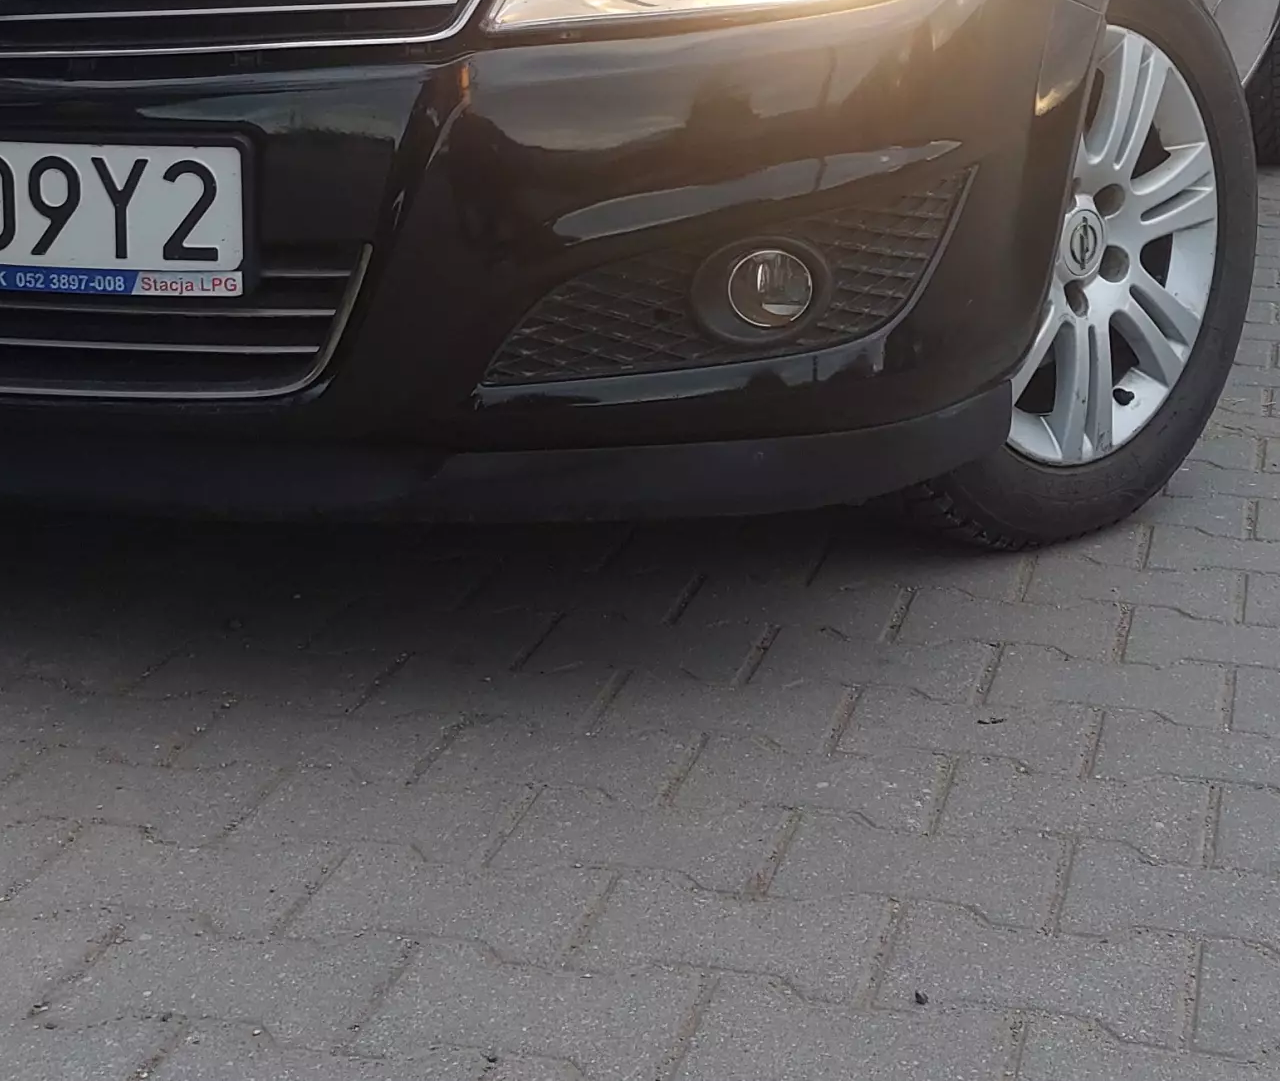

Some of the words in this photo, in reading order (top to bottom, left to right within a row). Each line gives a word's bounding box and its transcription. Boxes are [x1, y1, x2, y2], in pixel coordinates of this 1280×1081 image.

[15, 274, 46, 289] 052
[49, 275, 126, 292] 3897-008
[140, 276, 195, 295] Stacja
[200, 277, 238, 293] LPG
